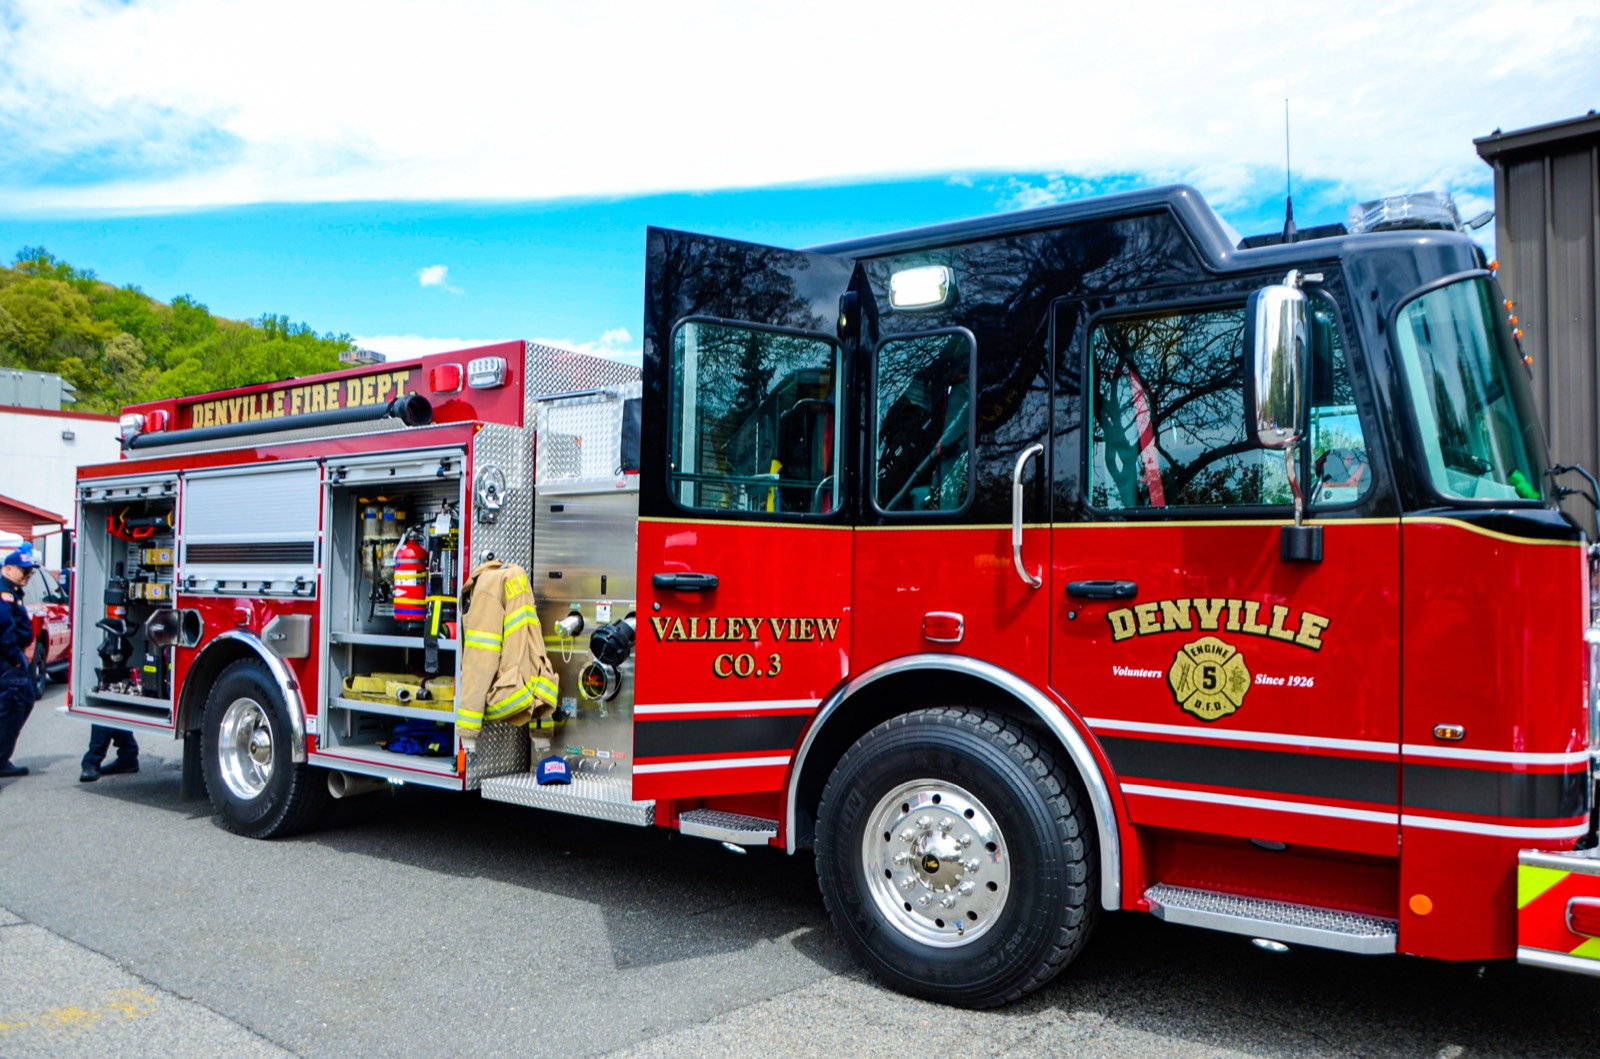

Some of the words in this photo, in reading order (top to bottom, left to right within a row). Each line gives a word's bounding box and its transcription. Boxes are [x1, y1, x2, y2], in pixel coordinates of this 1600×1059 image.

[192, 390, 286, 429] DENVILLE
[290, 381, 340, 416] FIRE
[649, 616, 765, 642] VALLEY
[769, 617, 841, 642] VIEW
[1107, 597, 1331, 651] DENVILLE
[1190, 643, 1230, 659] ENGINE
[713, 652, 763, 678] CO.
[767, 652, 783, 678] 3
[1112, 665, 1163, 679] Volunteers
[1202, 666, 1217, 690] 5
[1254, 673, 1285, 686] Since
[1286, 675, 1315, 688] 1926
[1194, 699, 1226, 711] D.F.D.
